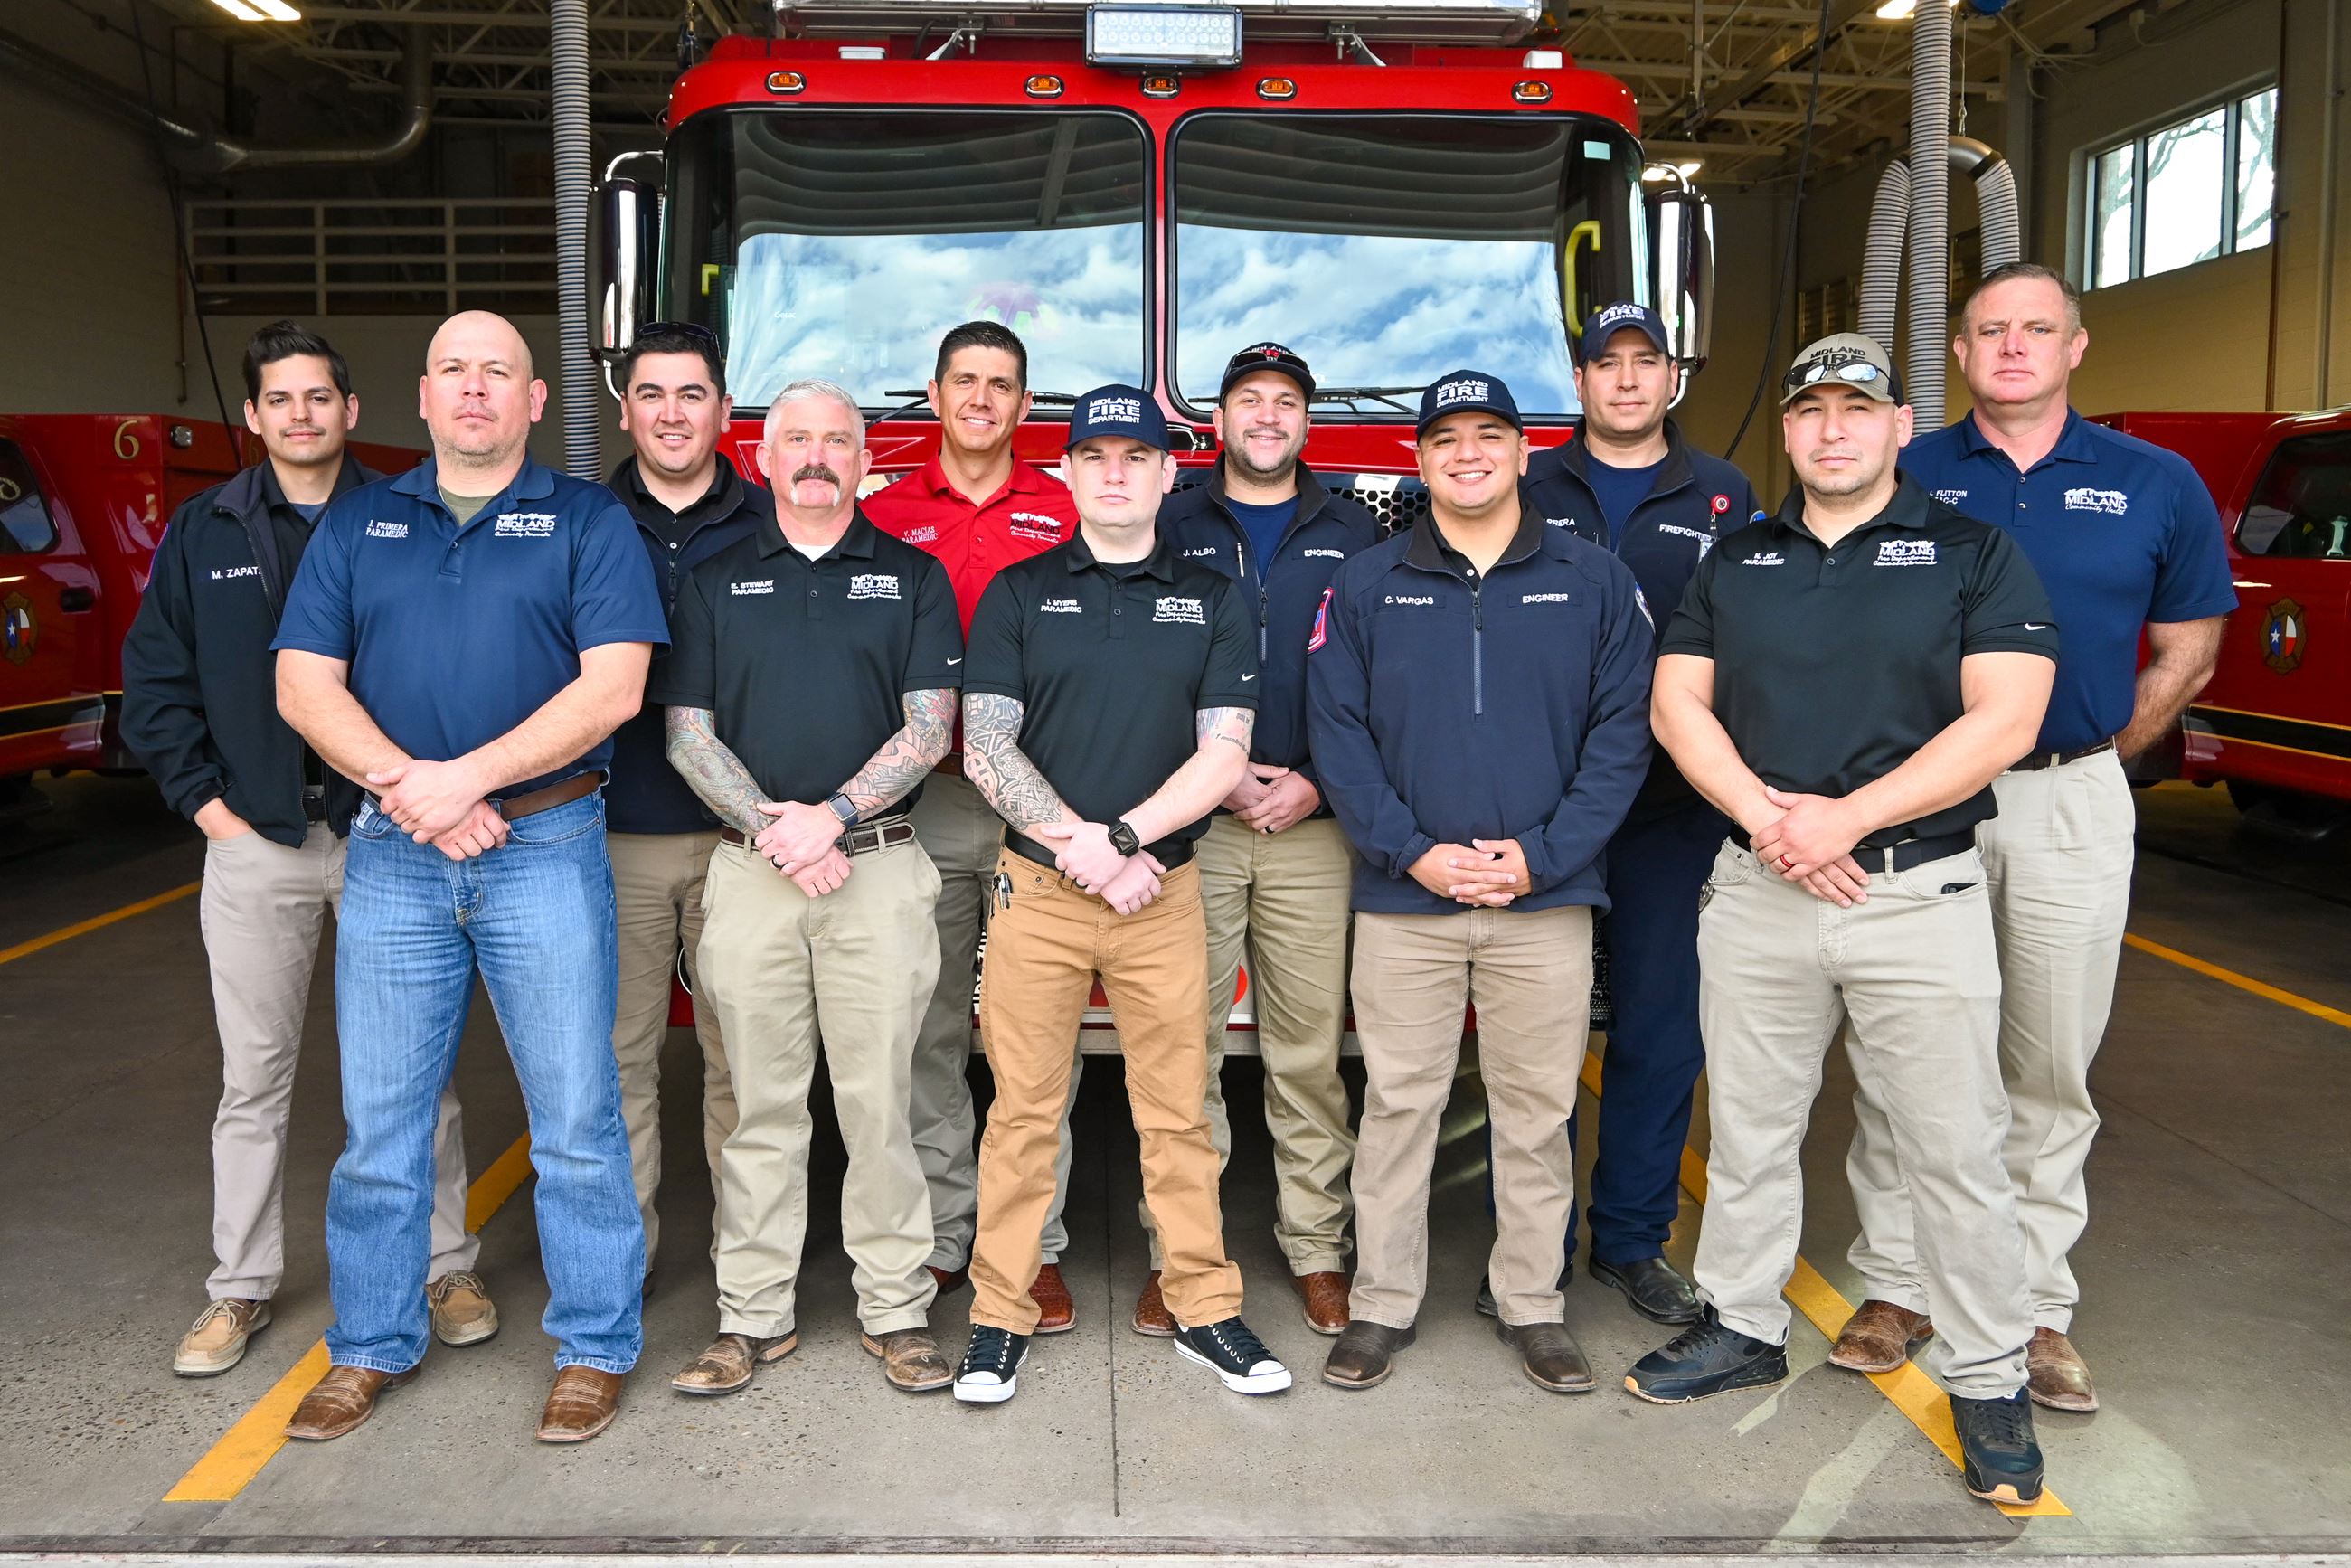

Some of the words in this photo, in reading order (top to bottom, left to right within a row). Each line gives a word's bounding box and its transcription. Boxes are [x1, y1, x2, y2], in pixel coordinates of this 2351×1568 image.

[1810, 346, 1866, 359] MIDLAND
[1437, 379, 1489, 393] MIDLAND
[1437, 385, 1489, 403] FIRE
[1089, 397, 1141, 408] MIDLAND
[1436, 395, 1489, 409] DEPARTMENT
[1088, 404, 1141, 419] FIRE
[1088, 414, 1140, 425] DEPARTMENT
[114, 420, 140, 460] 6
[1936, 489, 1968, 498] FLITTON
[2064, 495, 2128, 510] MIDLAND
[496, 519, 556, 528] MIDLAND
[1010, 518, 1061, 534] MIDLAND
[365, 527, 408, 538] PARAMEDIC
[901, 532, 939, 544] PARAMEDIC
[1191, 547, 1217, 557] ALBO
[1304, 548, 1345, 560] ENGINEER
[1762, 552, 1779, 560] JOY
[1879, 545, 1935, 556] MIDLAND
[1742, 558, 1785, 566] PARAMEDIC
[212, 570, 223, 580] M.
[226, 565, 261, 579] ZAPAT
[740, 580, 775, 589] STEWART
[851, 579, 899, 590] MIDLAND
[732, 586, 774, 596] PARAMEDIC
[1384, 595, 1394, 604] C.
[1395, 595, 1434, 606] VARGAS
[1522, 593, 1569, 604] ENGINEER
[1041, 605, 1082, 614] PARAMEDIC
[1156, 602, 1203, 613] MIDLAND
